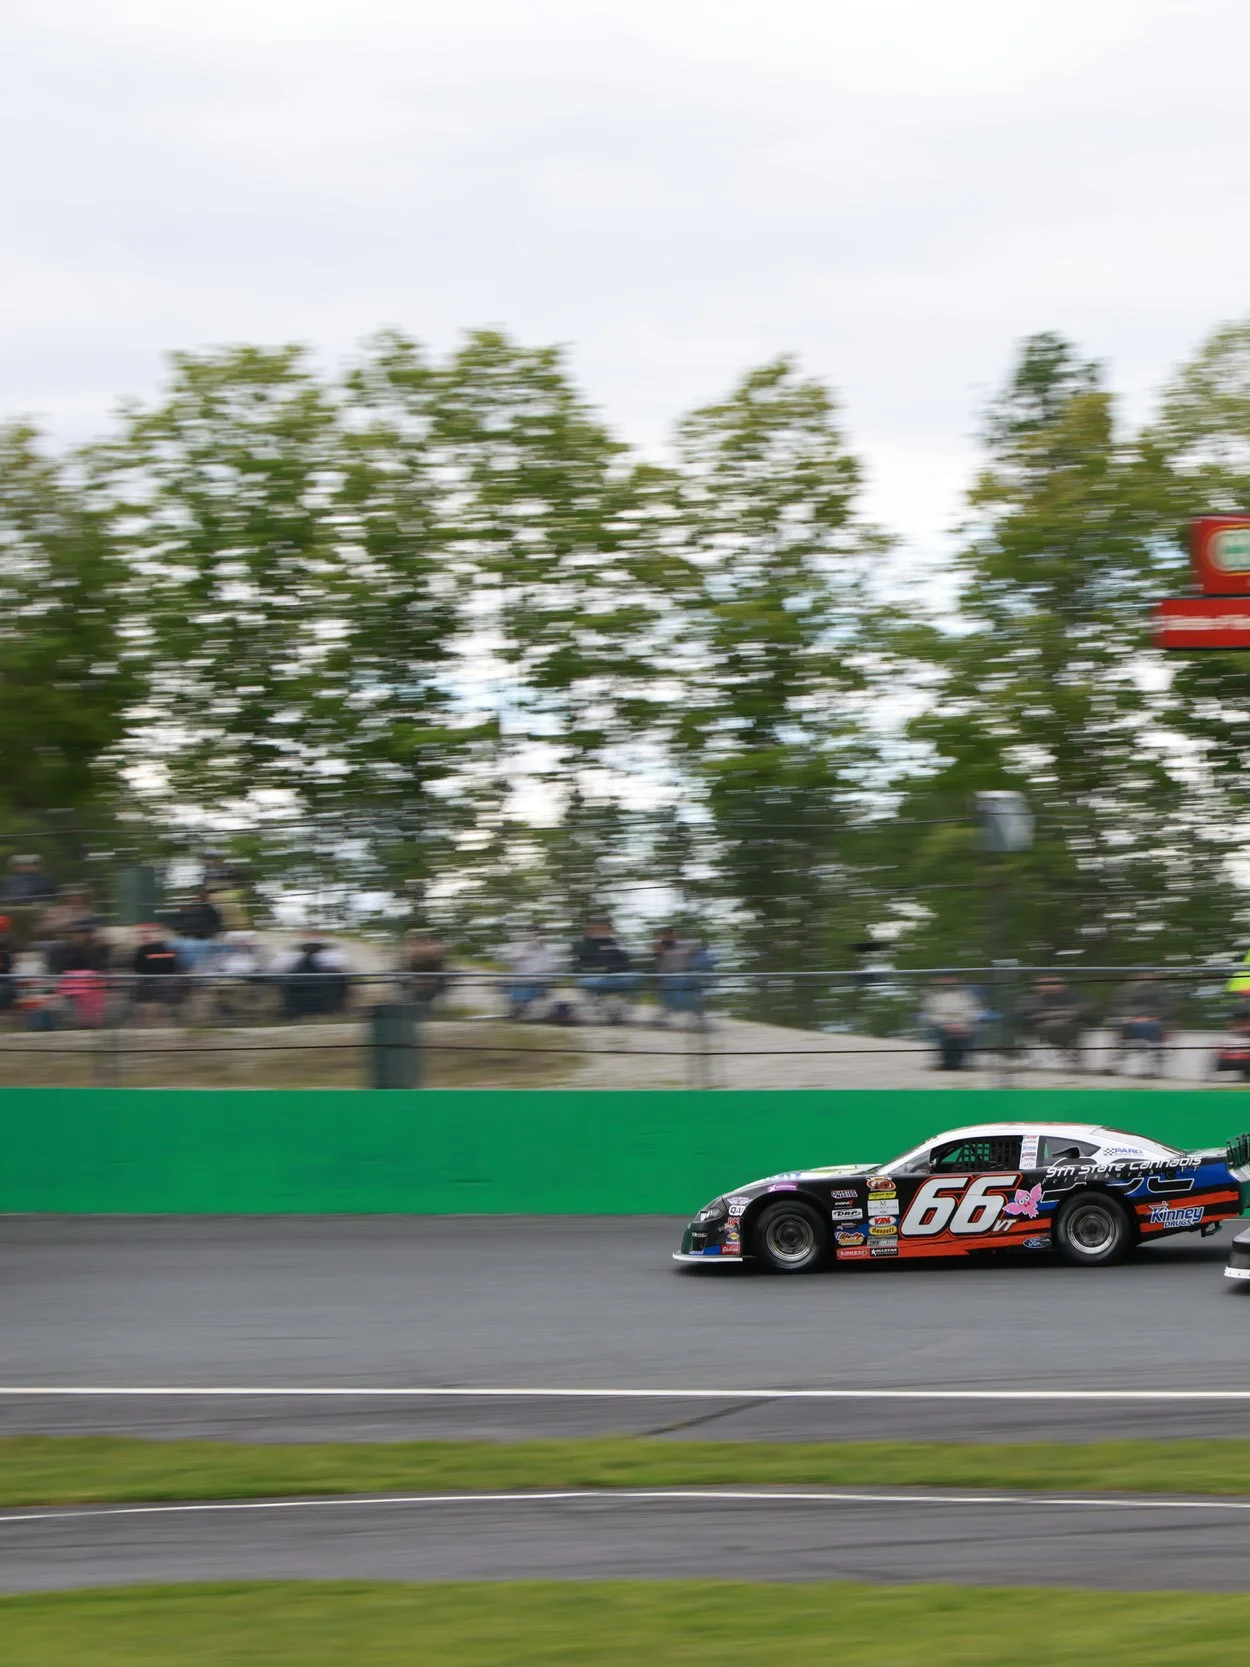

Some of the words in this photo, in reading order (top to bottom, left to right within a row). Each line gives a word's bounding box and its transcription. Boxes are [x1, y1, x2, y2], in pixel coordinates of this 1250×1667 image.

[899, 1174, 1020, 1238] 66
[992, 1218, 1017, 1232] VT
[1151, 1206, 1204, 1223] Kinney
[1164, 1220, 1191, 1228] DRUGS
